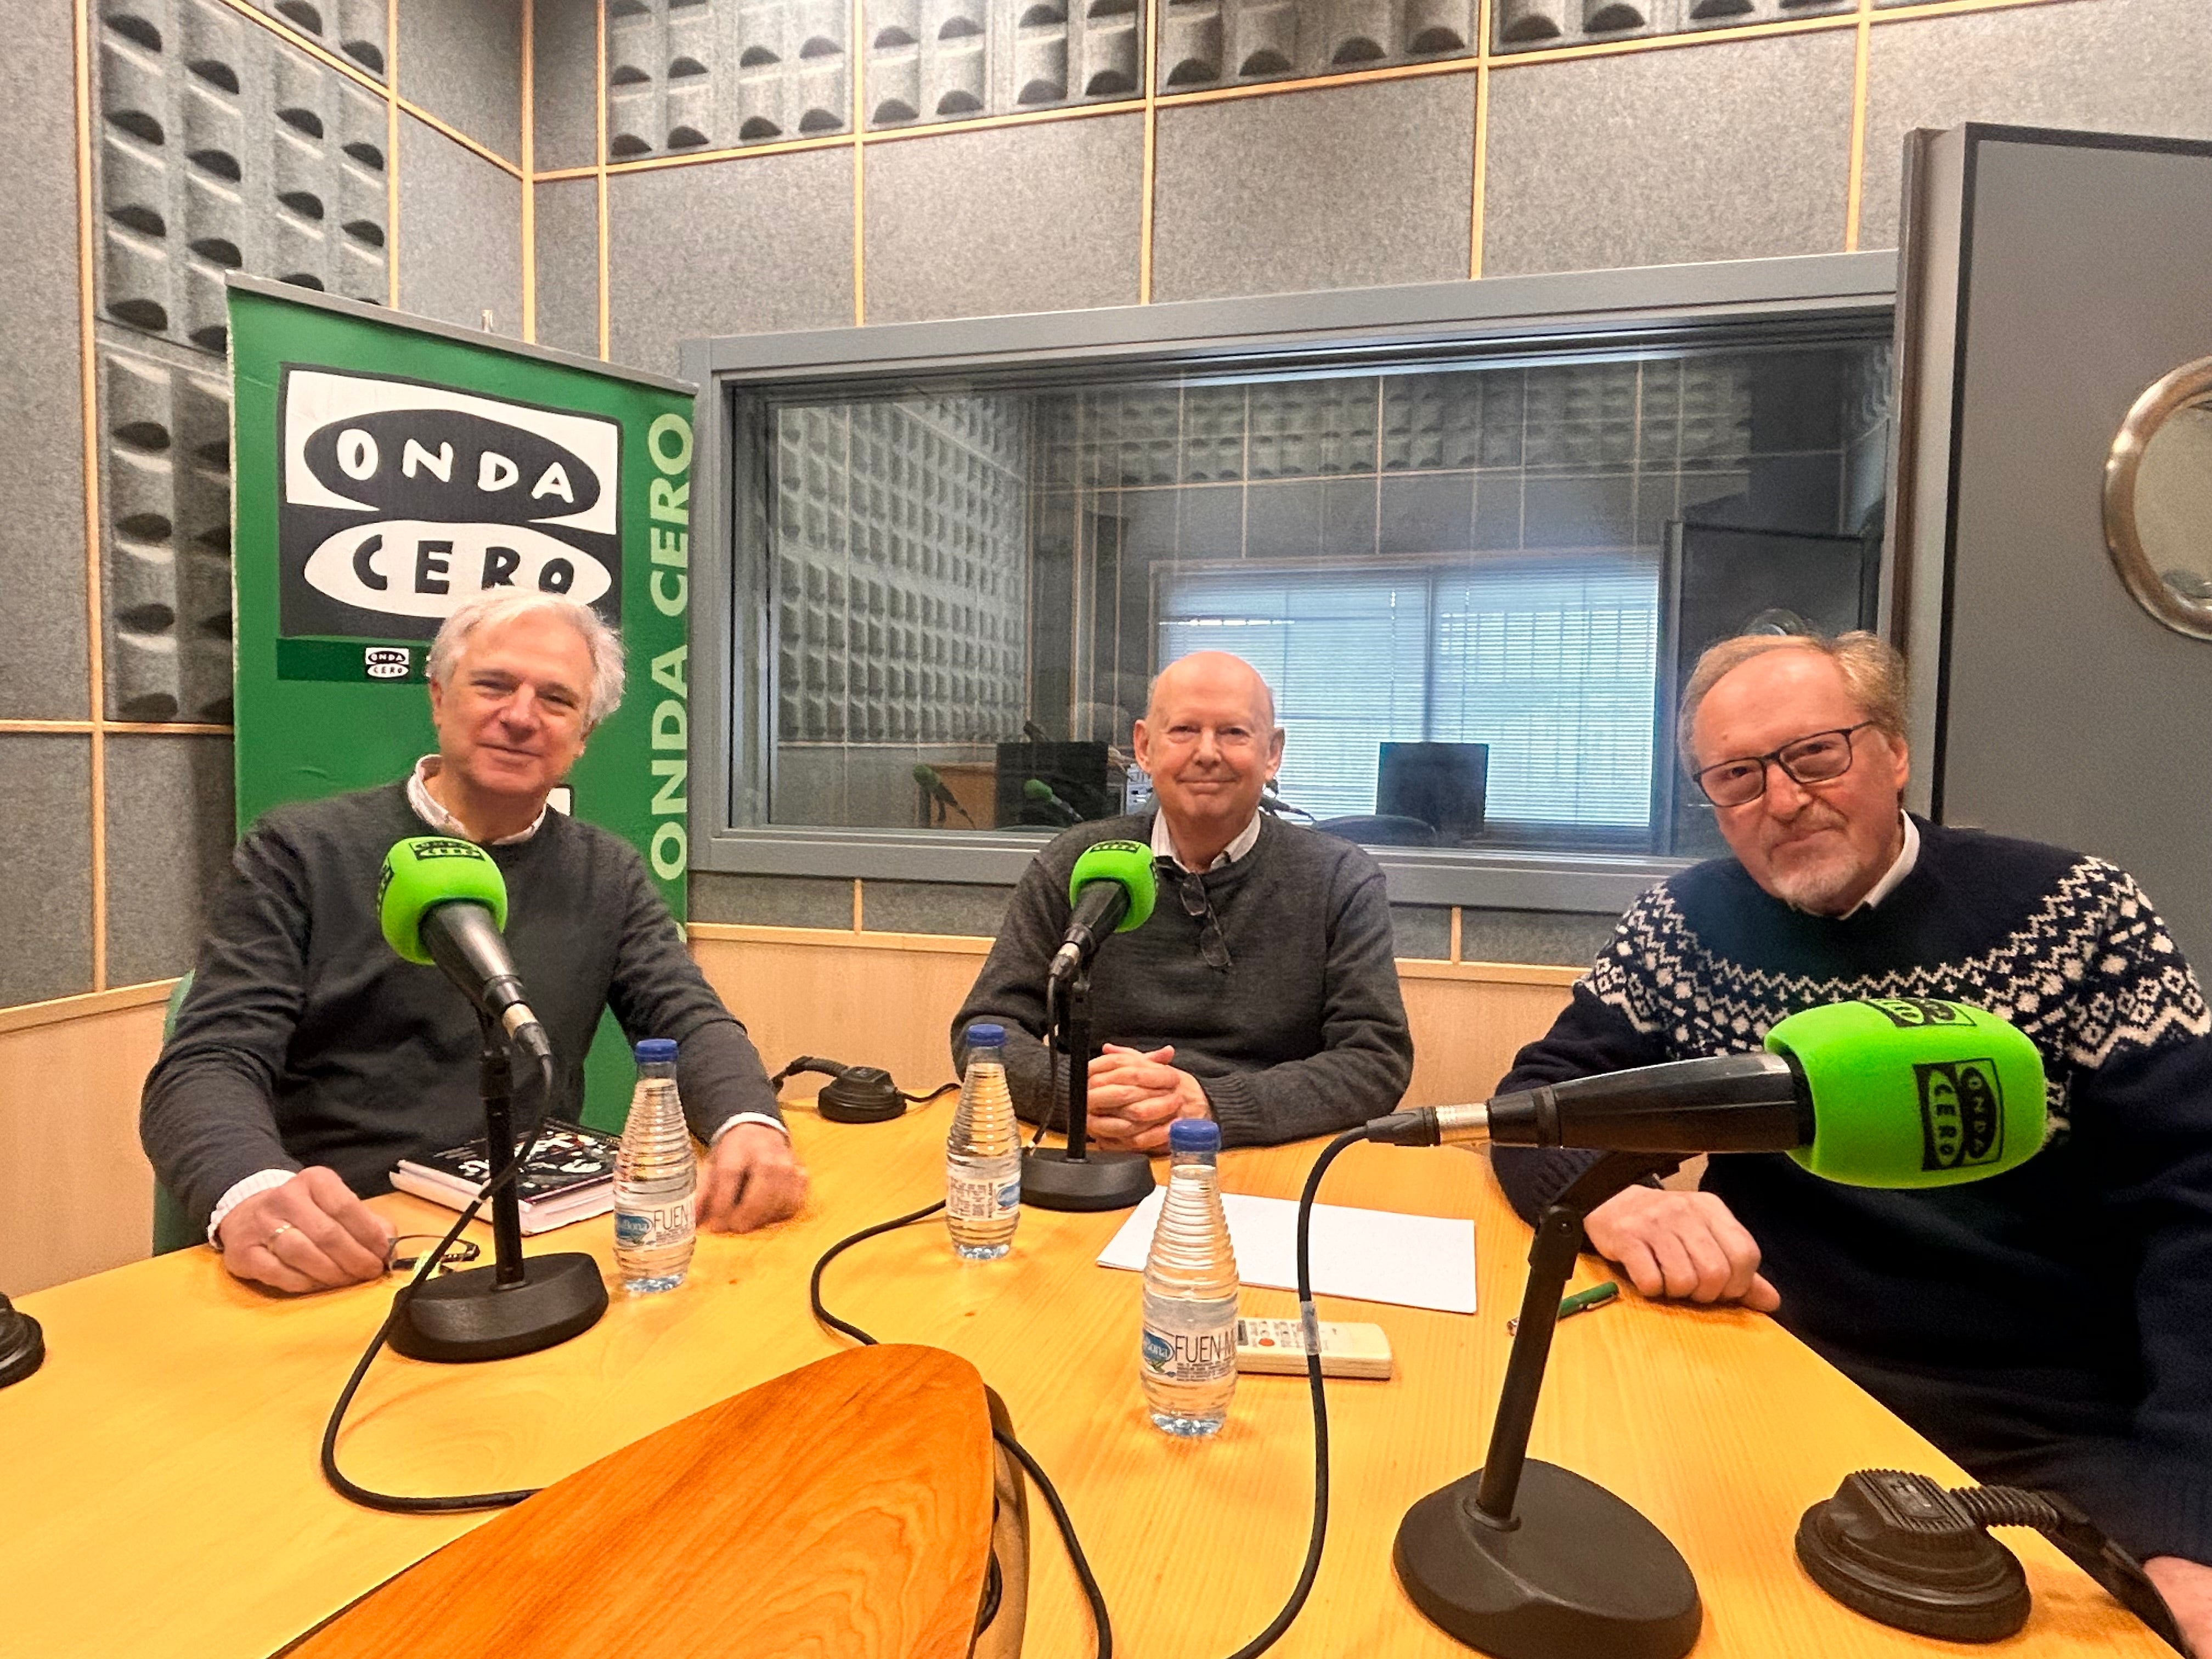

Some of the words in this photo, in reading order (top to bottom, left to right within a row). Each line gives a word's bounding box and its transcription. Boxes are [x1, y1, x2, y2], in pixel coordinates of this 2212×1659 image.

[336, 428, 574, 504] ONDA
[648, 413, 693, 617] CERO
[353, 534, 575, 595] CERO
[650, 644, 689, 881] ONDA
[1934, 1084, 1956, 1155] CERO
[1968, 1076, 1987, 1152] ONDA
